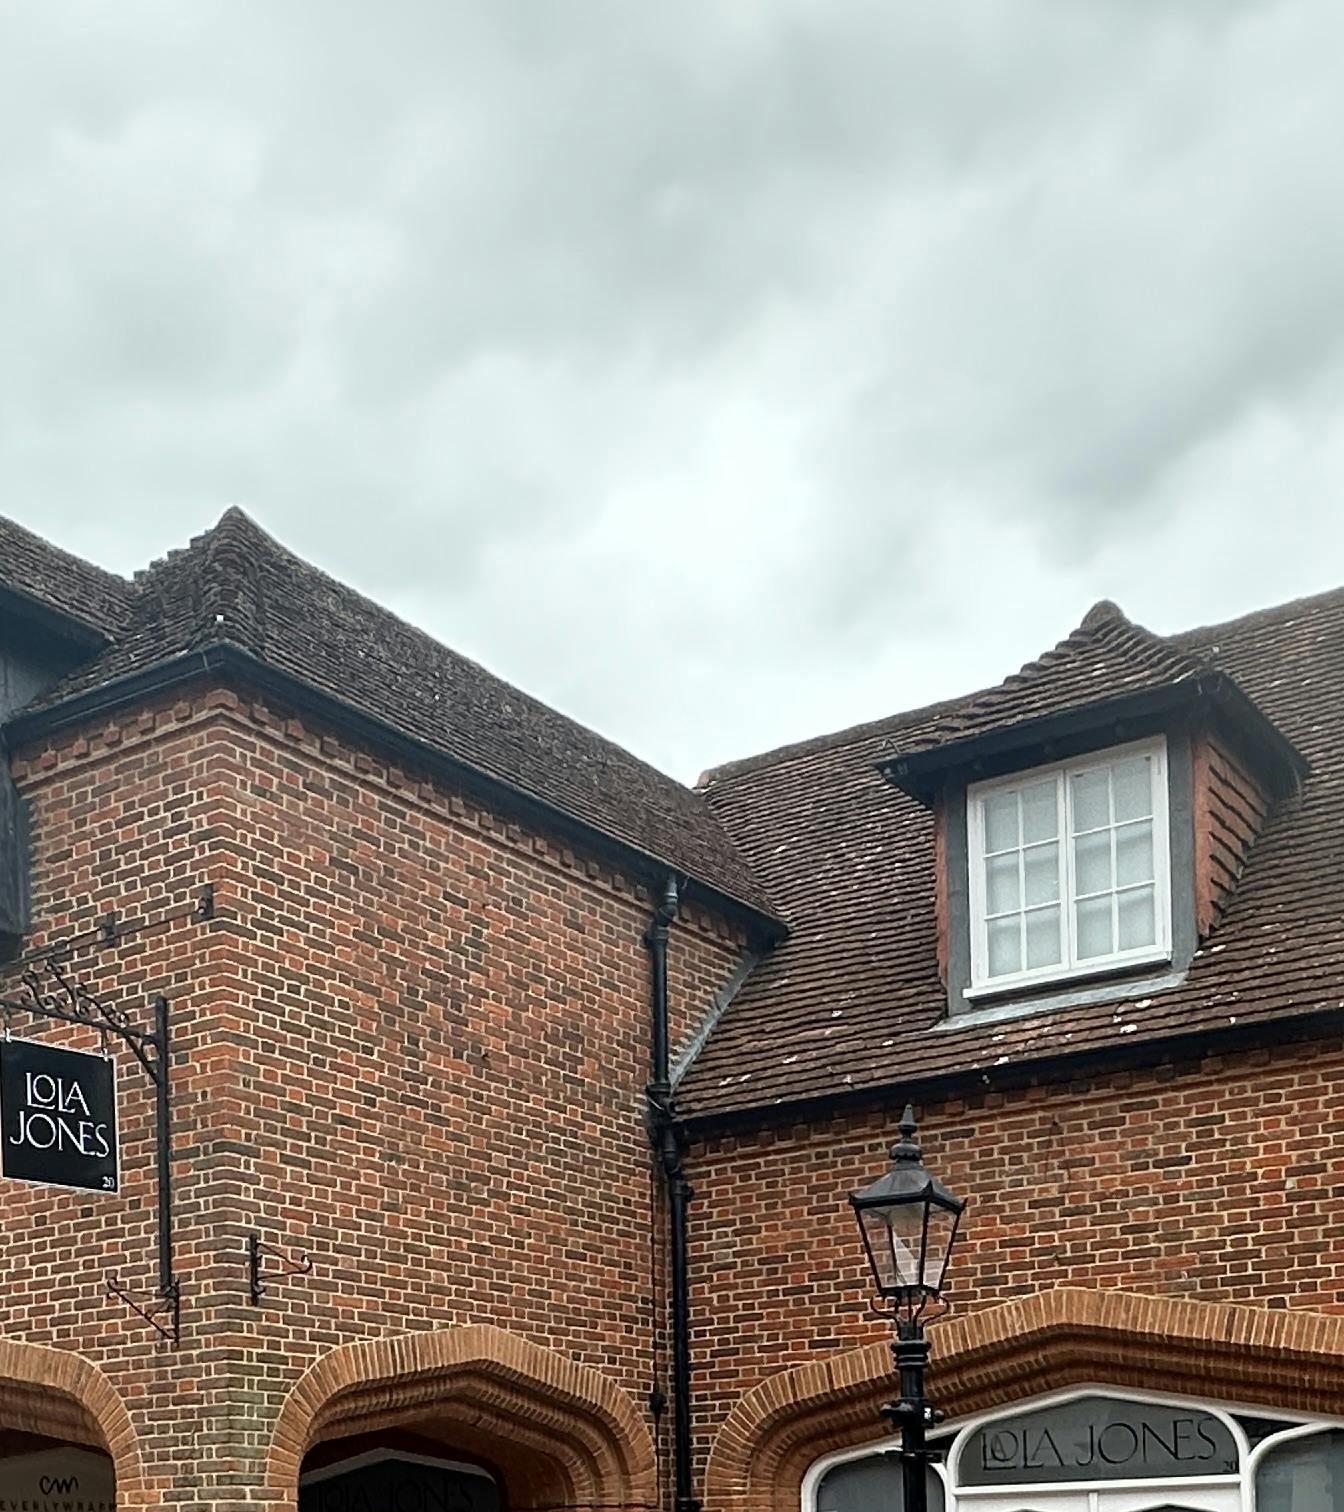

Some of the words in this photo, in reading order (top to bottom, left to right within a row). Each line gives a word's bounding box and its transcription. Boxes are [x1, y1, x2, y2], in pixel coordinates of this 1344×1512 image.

[26, 1072, 91, 1116] LOLA
[9, 1111, 109, 1157] JONES
[982, 1427, 1065, 1471] LOLA
[1074, 1416, 1217, 1467] JONES
